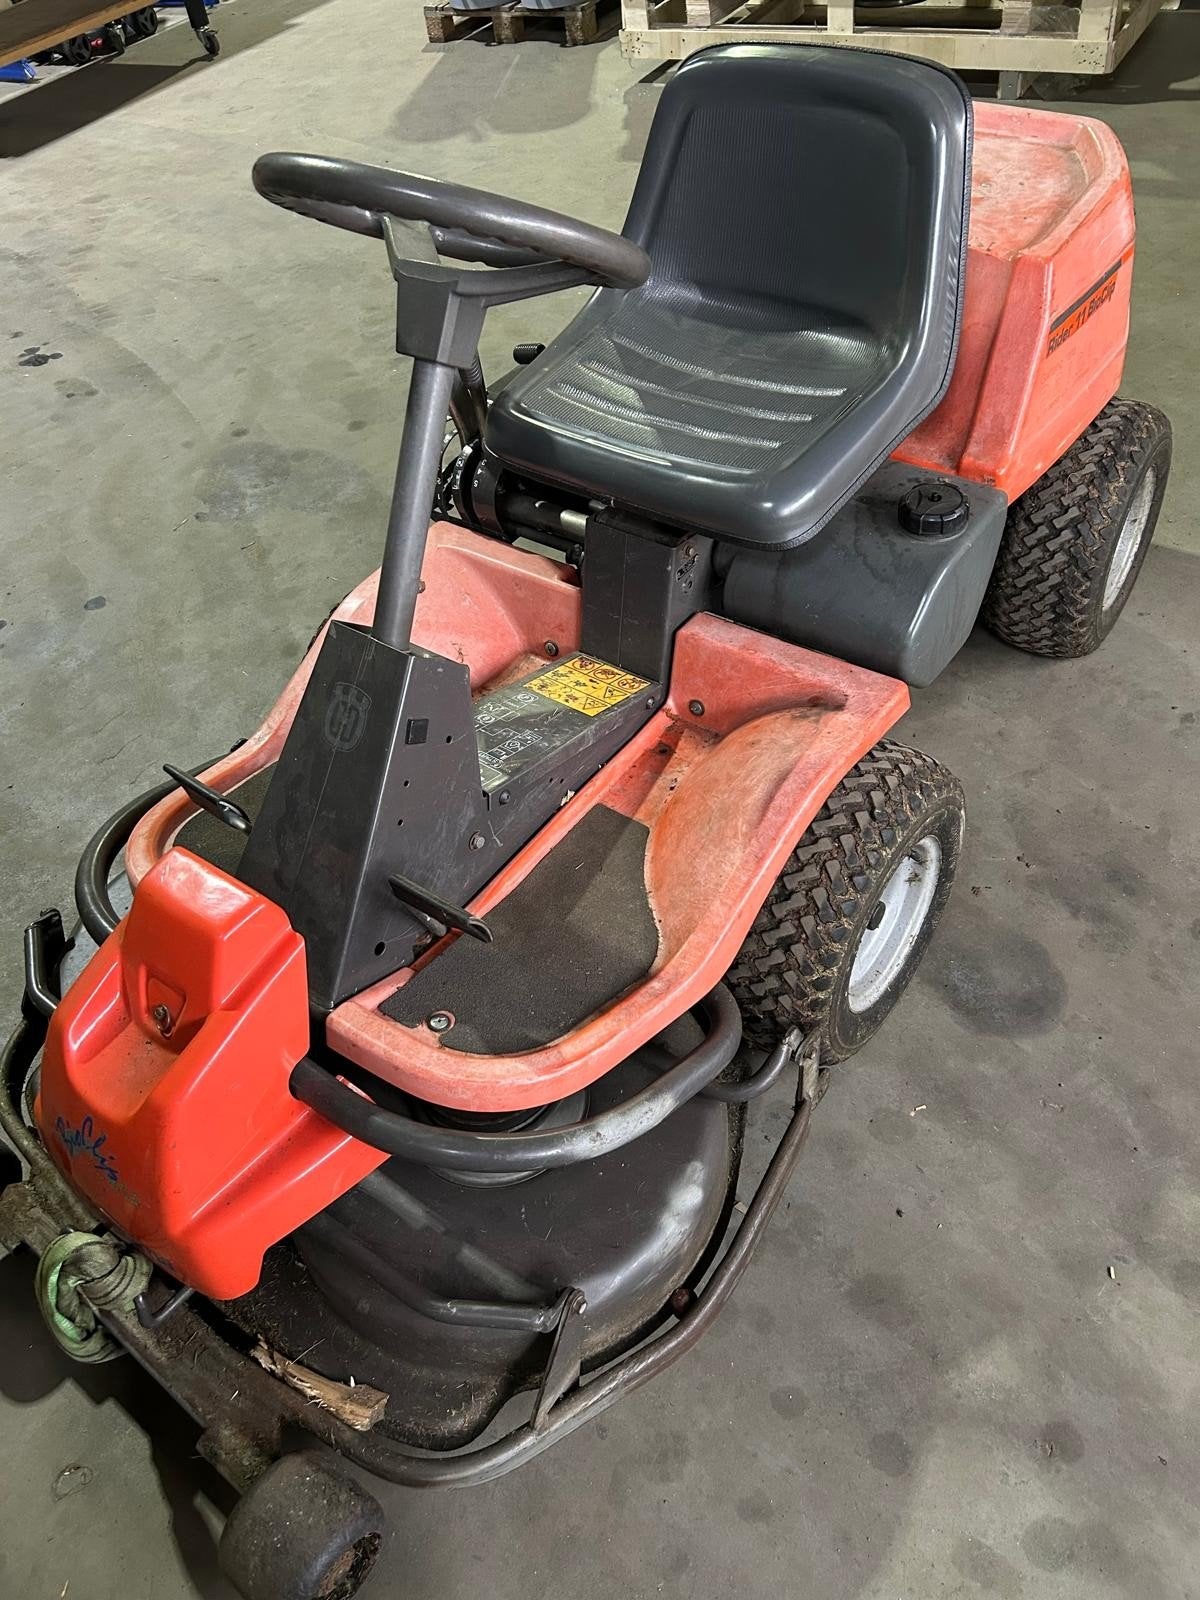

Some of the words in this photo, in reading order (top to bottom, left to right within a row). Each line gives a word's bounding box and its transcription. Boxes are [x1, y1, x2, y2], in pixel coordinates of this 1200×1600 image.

[1047, 325, 1074, 357] Rider
[1076, 306, 1087, 329] 11
[1087, 279, 1116, 318] BioClip
